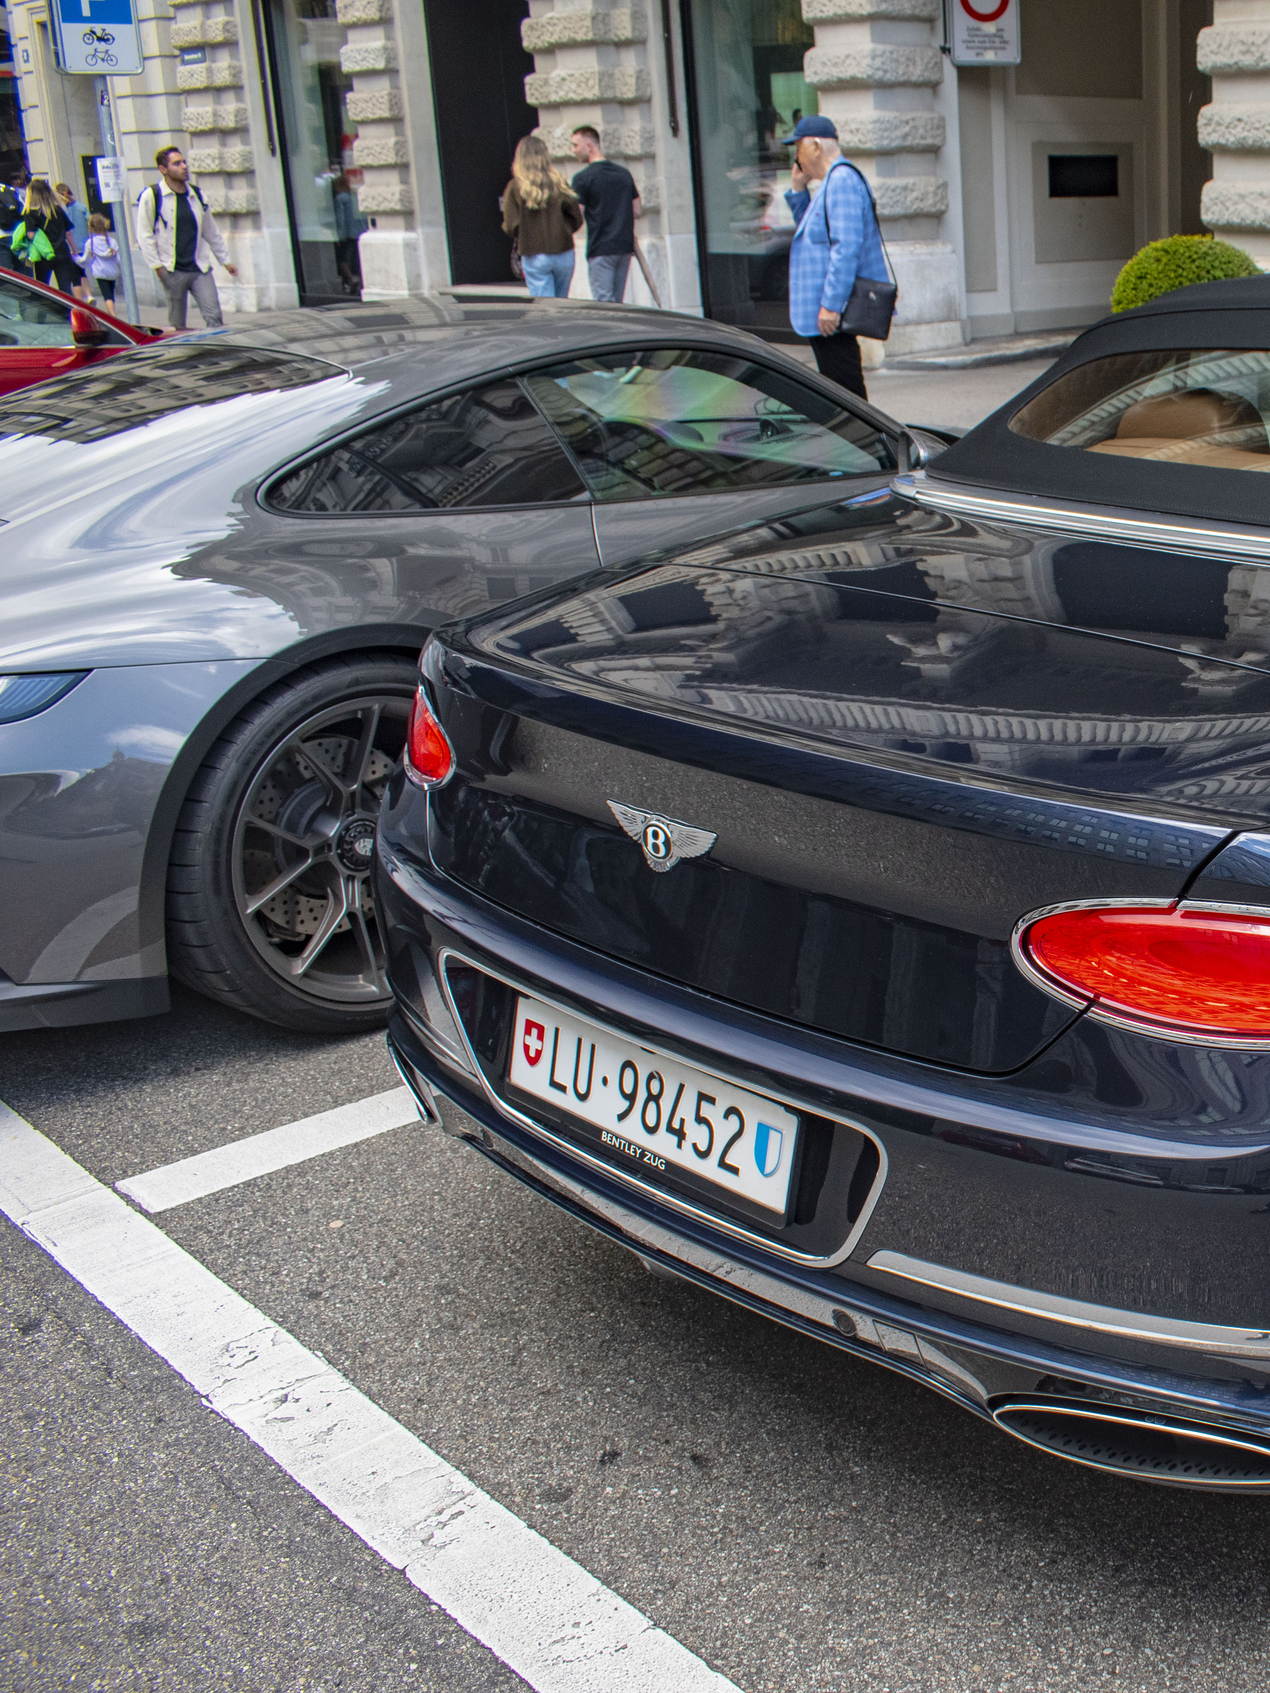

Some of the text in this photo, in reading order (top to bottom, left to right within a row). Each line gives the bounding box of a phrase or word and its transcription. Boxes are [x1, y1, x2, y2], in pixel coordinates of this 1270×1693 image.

[645, 825, 667, 858] B
[601, 1130, 667, 1171] BENTLEY ZUG
